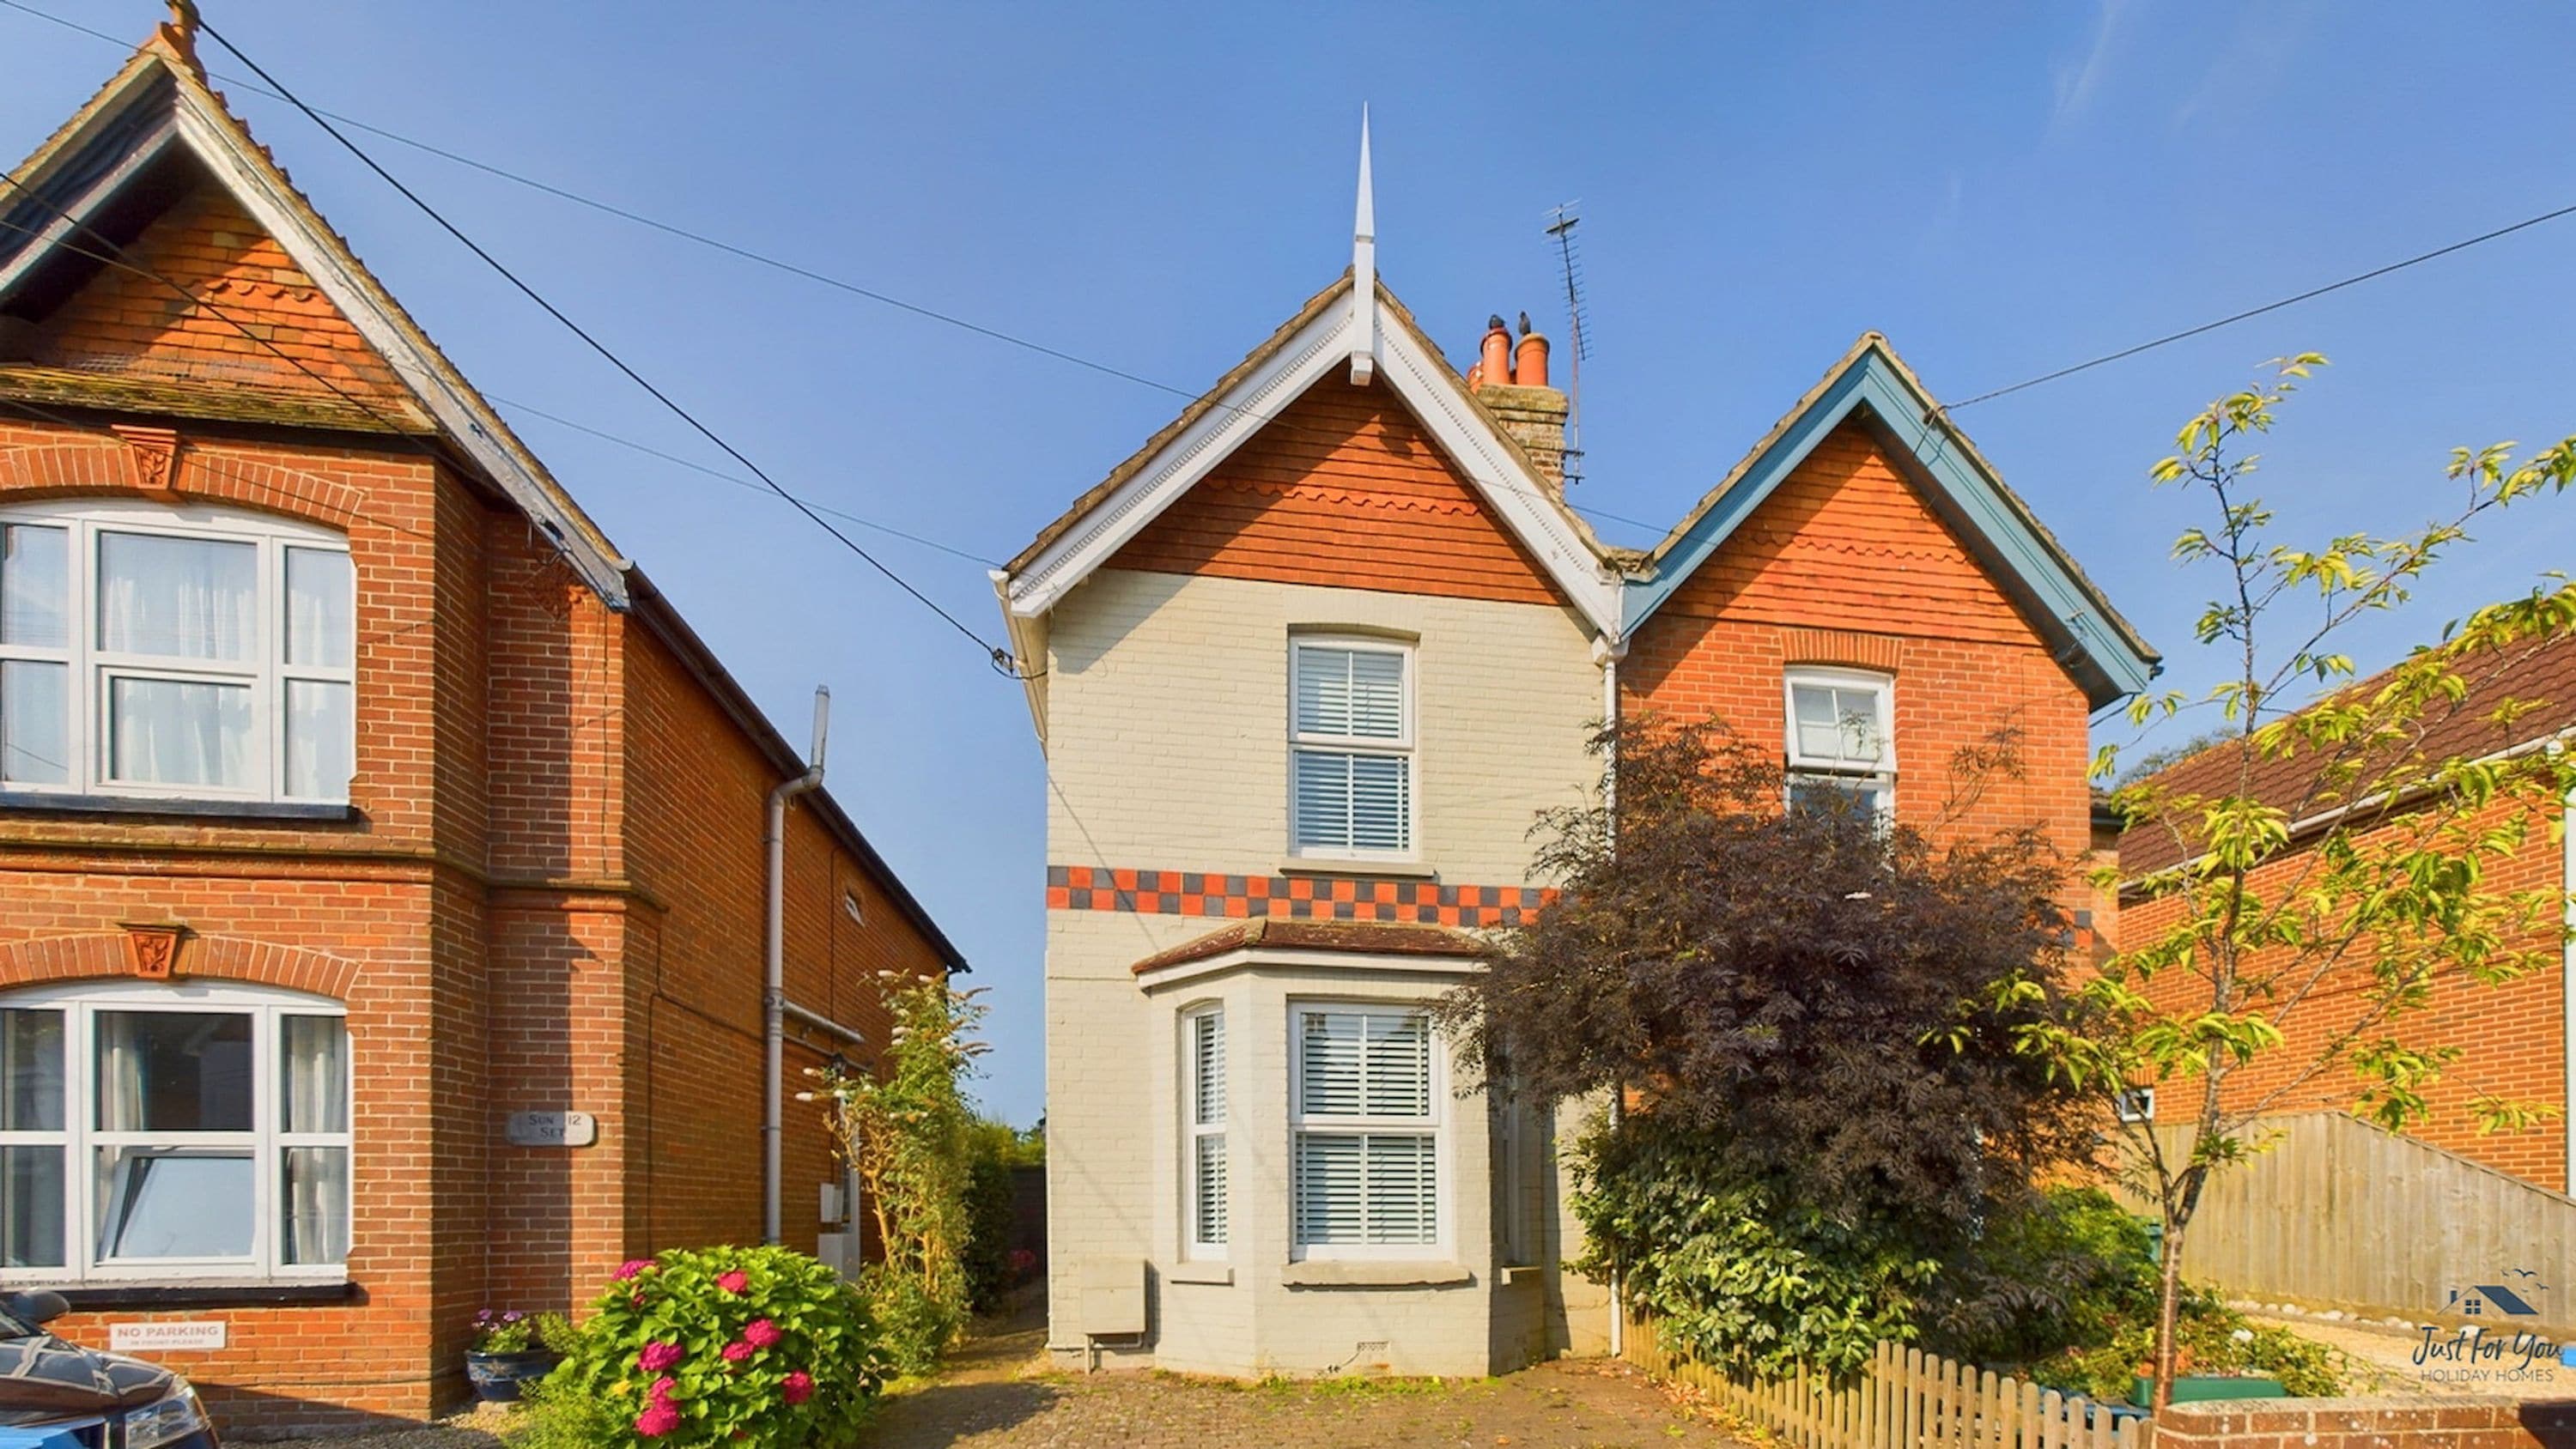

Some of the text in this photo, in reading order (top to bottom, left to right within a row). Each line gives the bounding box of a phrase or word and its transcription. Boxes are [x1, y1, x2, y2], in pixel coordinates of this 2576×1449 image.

[568, 1115, 581, 1125] 12
[118, 1325, 218, 1337] NO PARKING
